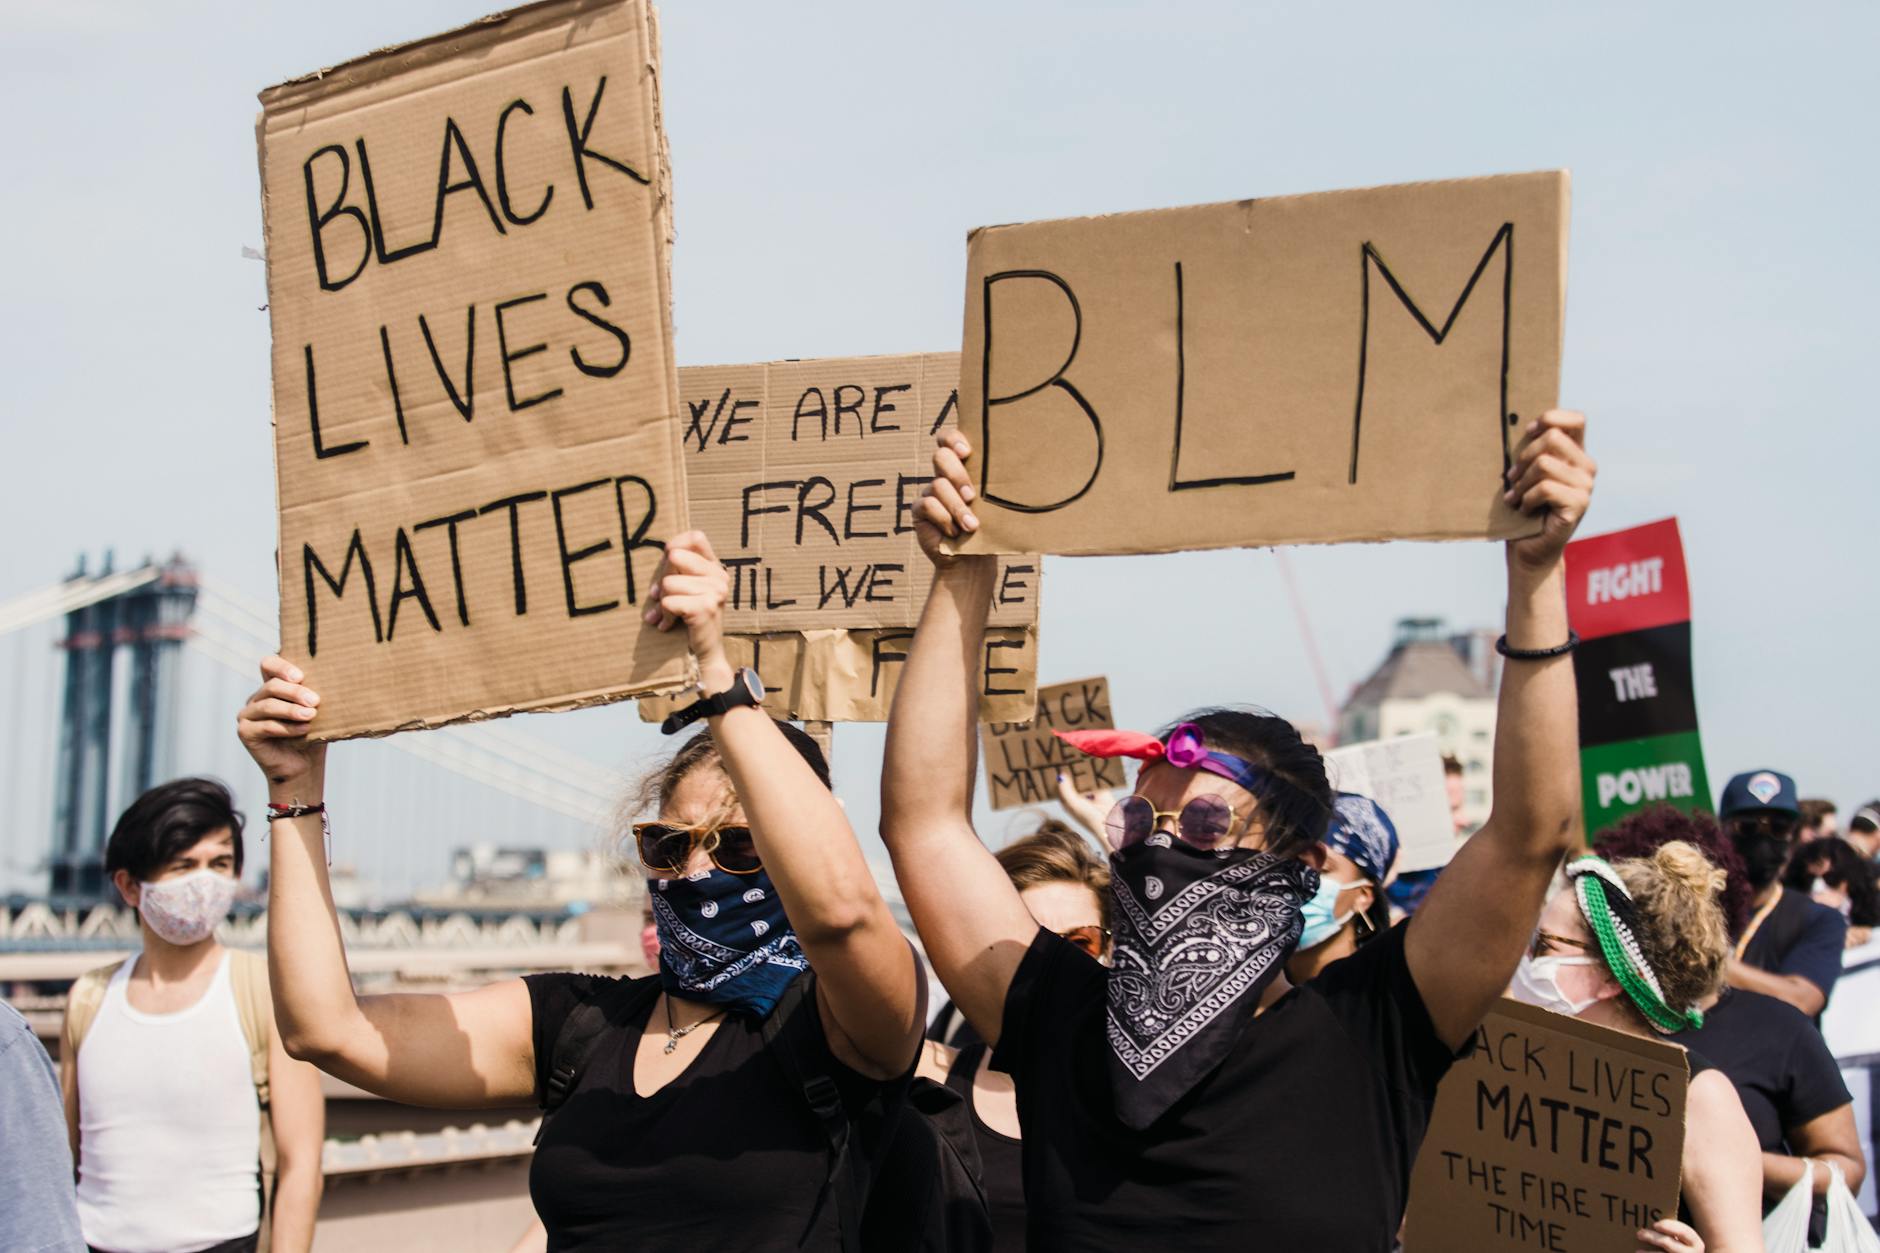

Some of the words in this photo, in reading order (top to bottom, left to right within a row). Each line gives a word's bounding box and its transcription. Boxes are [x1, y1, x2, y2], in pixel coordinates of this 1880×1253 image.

[304, 75, 651, 291] BLACK
[305, 281, 631, 460] LIVES
[792, 384, 912, 441] ARE
[304, 475, 666, 657] MATTER
[818, 564, 905, 610] WE
[1587, 557, 1664, 605] FIGHT
[1609, 663, 1657, 702] THE
[1001, 728, 1092, 773] LIVE
[1597, 762, 1694, 808] POWER
[1472, 1024, 1547, 1081] ACK
[1569, 1051, 1672, 1118] LIVES
[1476, 1080, 1654, 1179] MATTER
[1441, 1151, 1507, 1195] THE
[1520, 1172, 1592, 1218] FIRE
[1601, 1193, 1663, 1229] THIS
[1488, 1202, 1567, 1253] TIME
